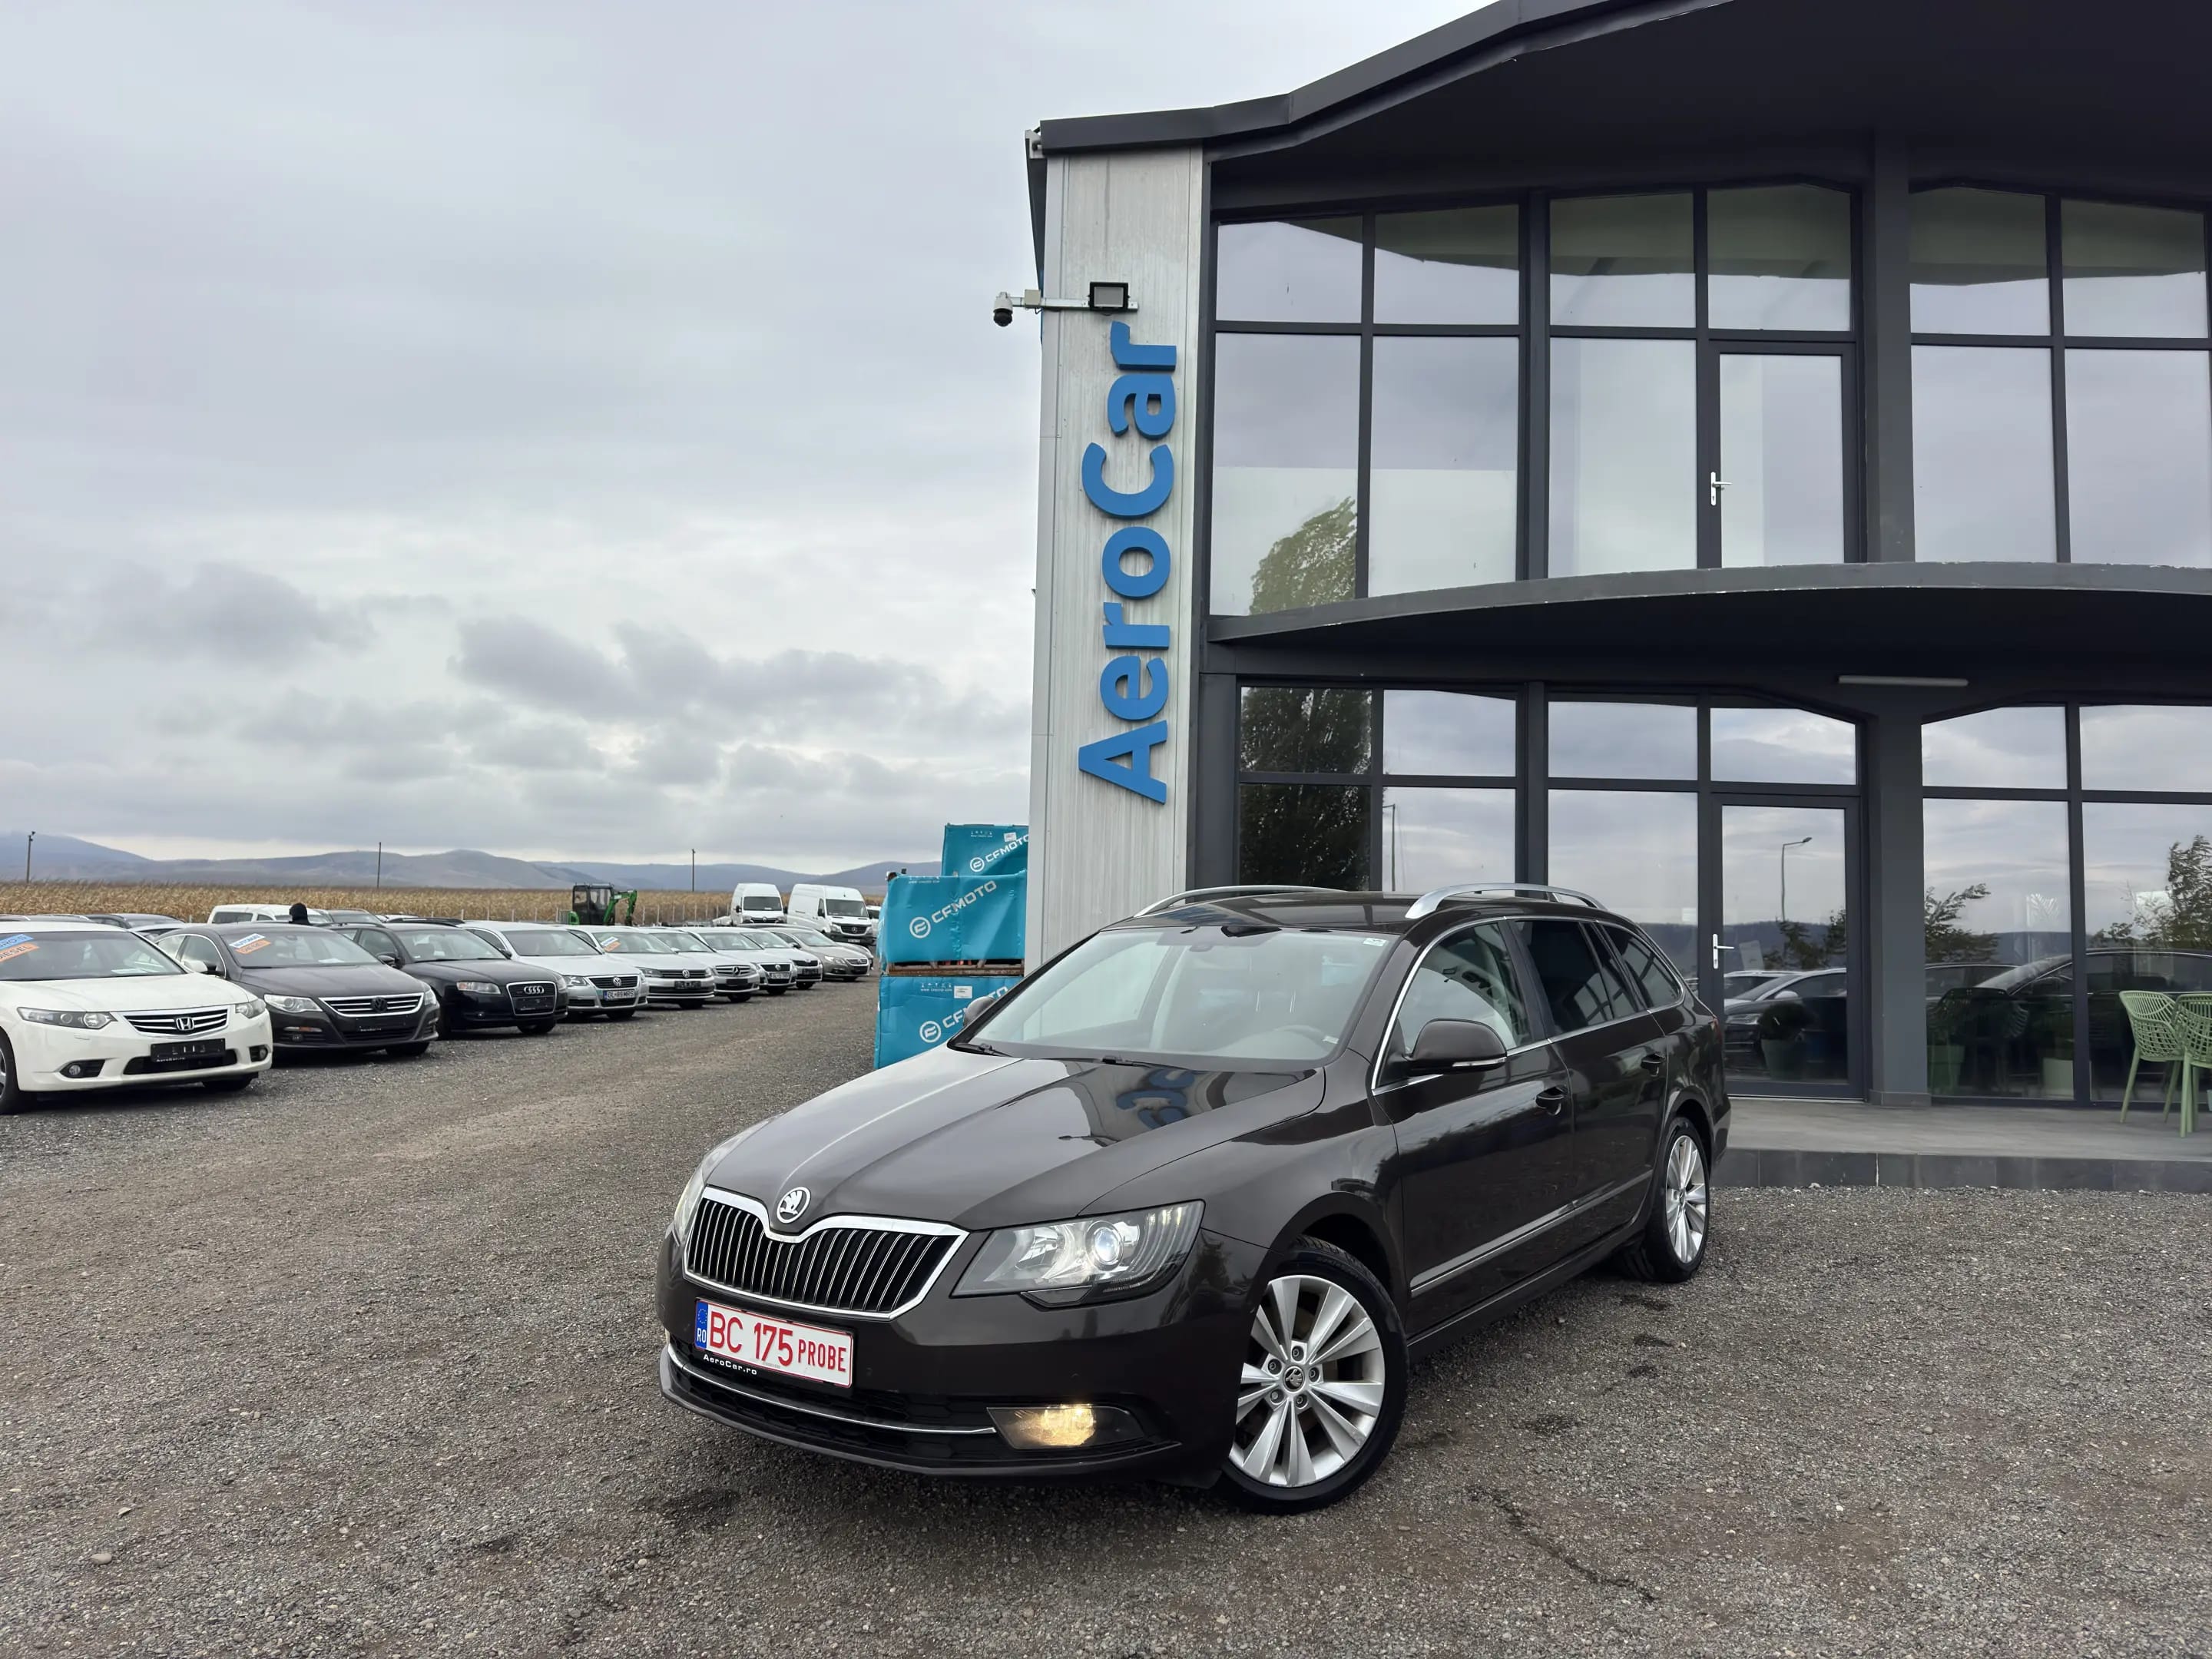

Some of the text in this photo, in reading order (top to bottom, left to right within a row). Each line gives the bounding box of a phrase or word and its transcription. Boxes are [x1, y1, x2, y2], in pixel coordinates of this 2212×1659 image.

[1078, 321, 1177, 805] AeroCar
[931, 880, 997, 923] CFMOTO
[696, 1327, 707, 1343] RO
[710, 1310, 846, 1373] BC 175 PROBE
[703, 1353, 758, 1376] AeroCar.ro
